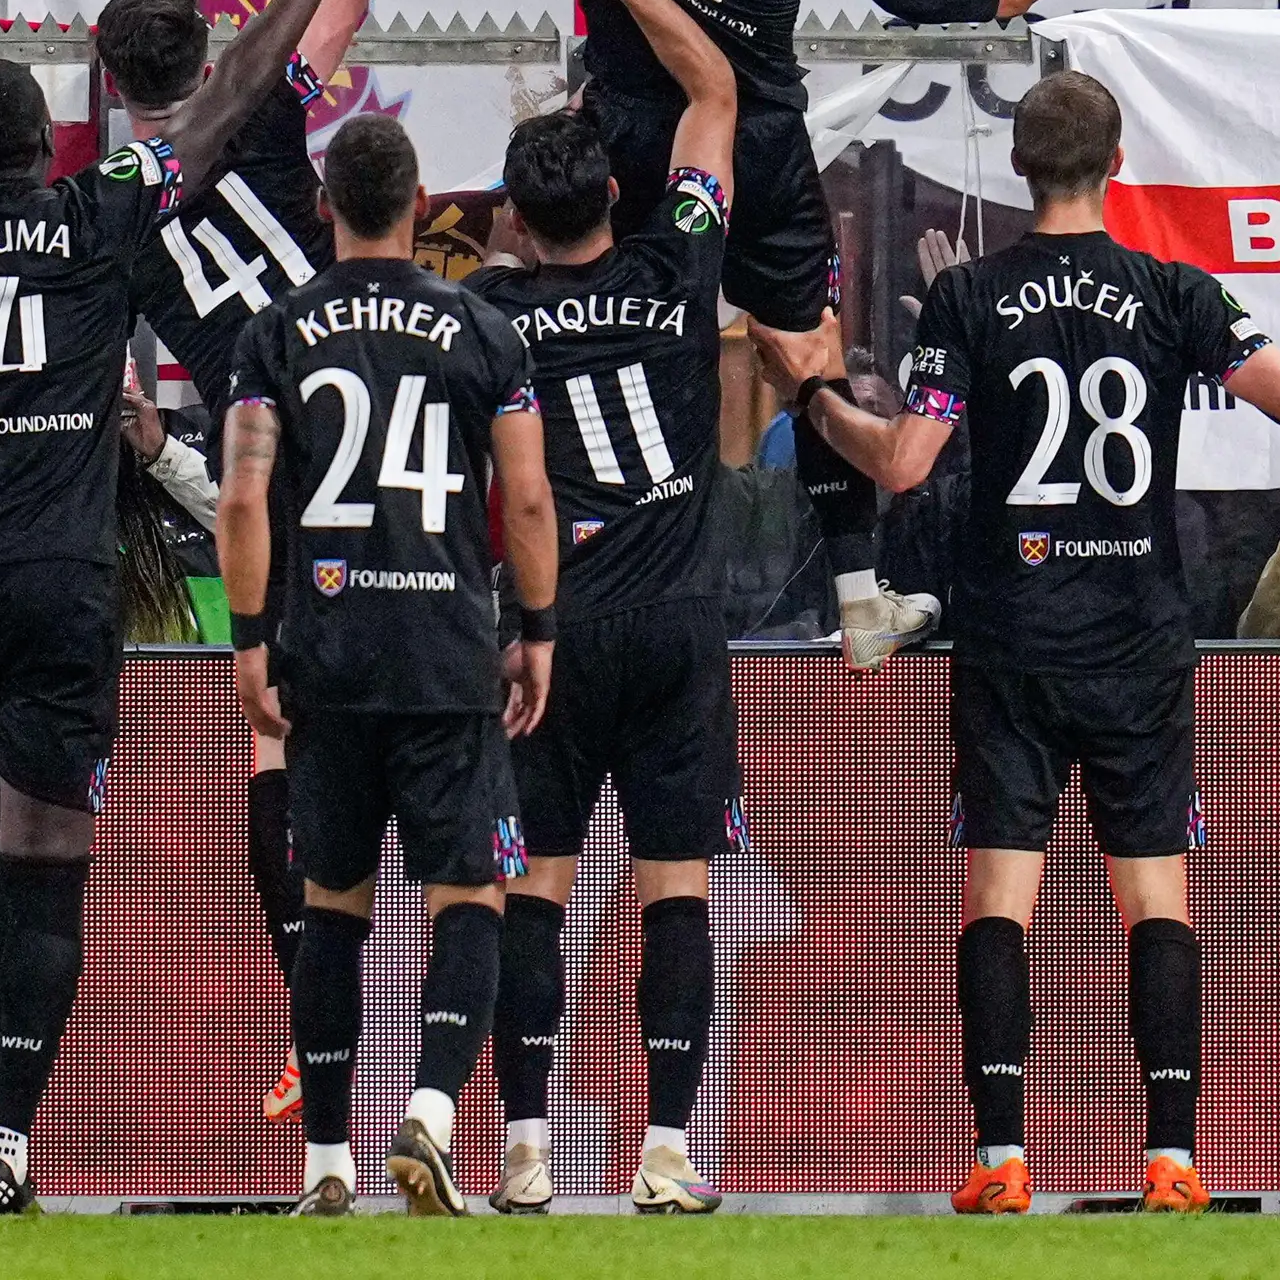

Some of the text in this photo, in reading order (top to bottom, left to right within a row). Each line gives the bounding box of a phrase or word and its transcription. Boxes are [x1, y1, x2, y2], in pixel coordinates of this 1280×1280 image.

[160, 170, 318, 320] 41
[996, 270, 1144, 330] SOUČEK
[296, 297, 462, 351] KEHRER
[510, 294, 688, 348] PAQUETÁ
[565, 362, 676, 485] 11
[1005, 356, 1153, 507] 28
[299, 367, 466, 534] 24
[634, 475, 694, 506] DATION
[808, 480, 848, 496] WHU
[1055, 536, 1152, 557] FOUNDATION
[349, 569, 456, 592] FOUNDATION
[424, 1011, 467, 1026] WHU
[1, 1035, 43, 1052] WHU
[648, 1037, 691, 1051] WHU
[305, 1048, 350, 1064] WHU
[981, 1063, 1022, 1076] WHU
[1150, 1068, 1191, 1081] WHU
